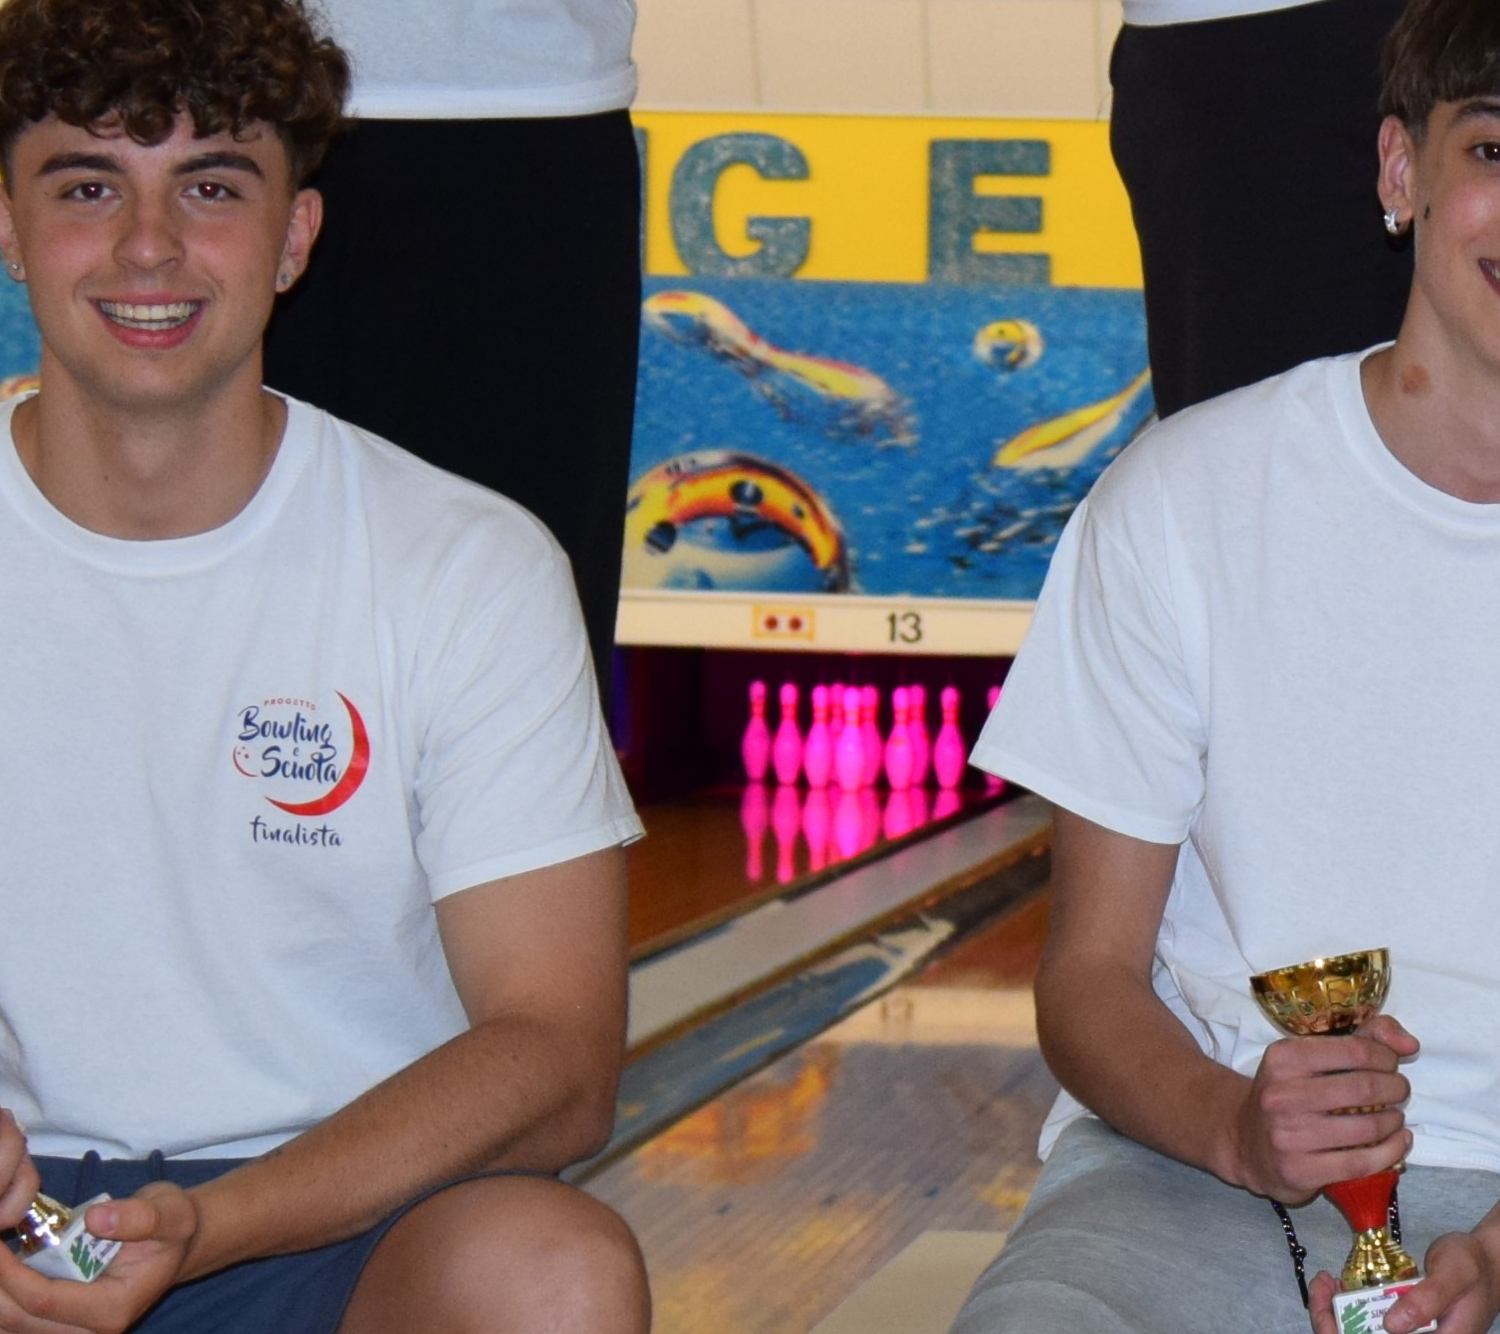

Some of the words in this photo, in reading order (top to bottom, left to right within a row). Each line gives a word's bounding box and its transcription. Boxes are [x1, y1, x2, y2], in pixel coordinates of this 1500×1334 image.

[927, 138, 1052, 285] E
[888, 612, 923, 643] 13
[263, 697, 316, 711] PROGETTO
[237, 705, 337, 757] Bowling
[260, 744, 342, 784] Scuola
[249, 815, 343, 847] finalista
